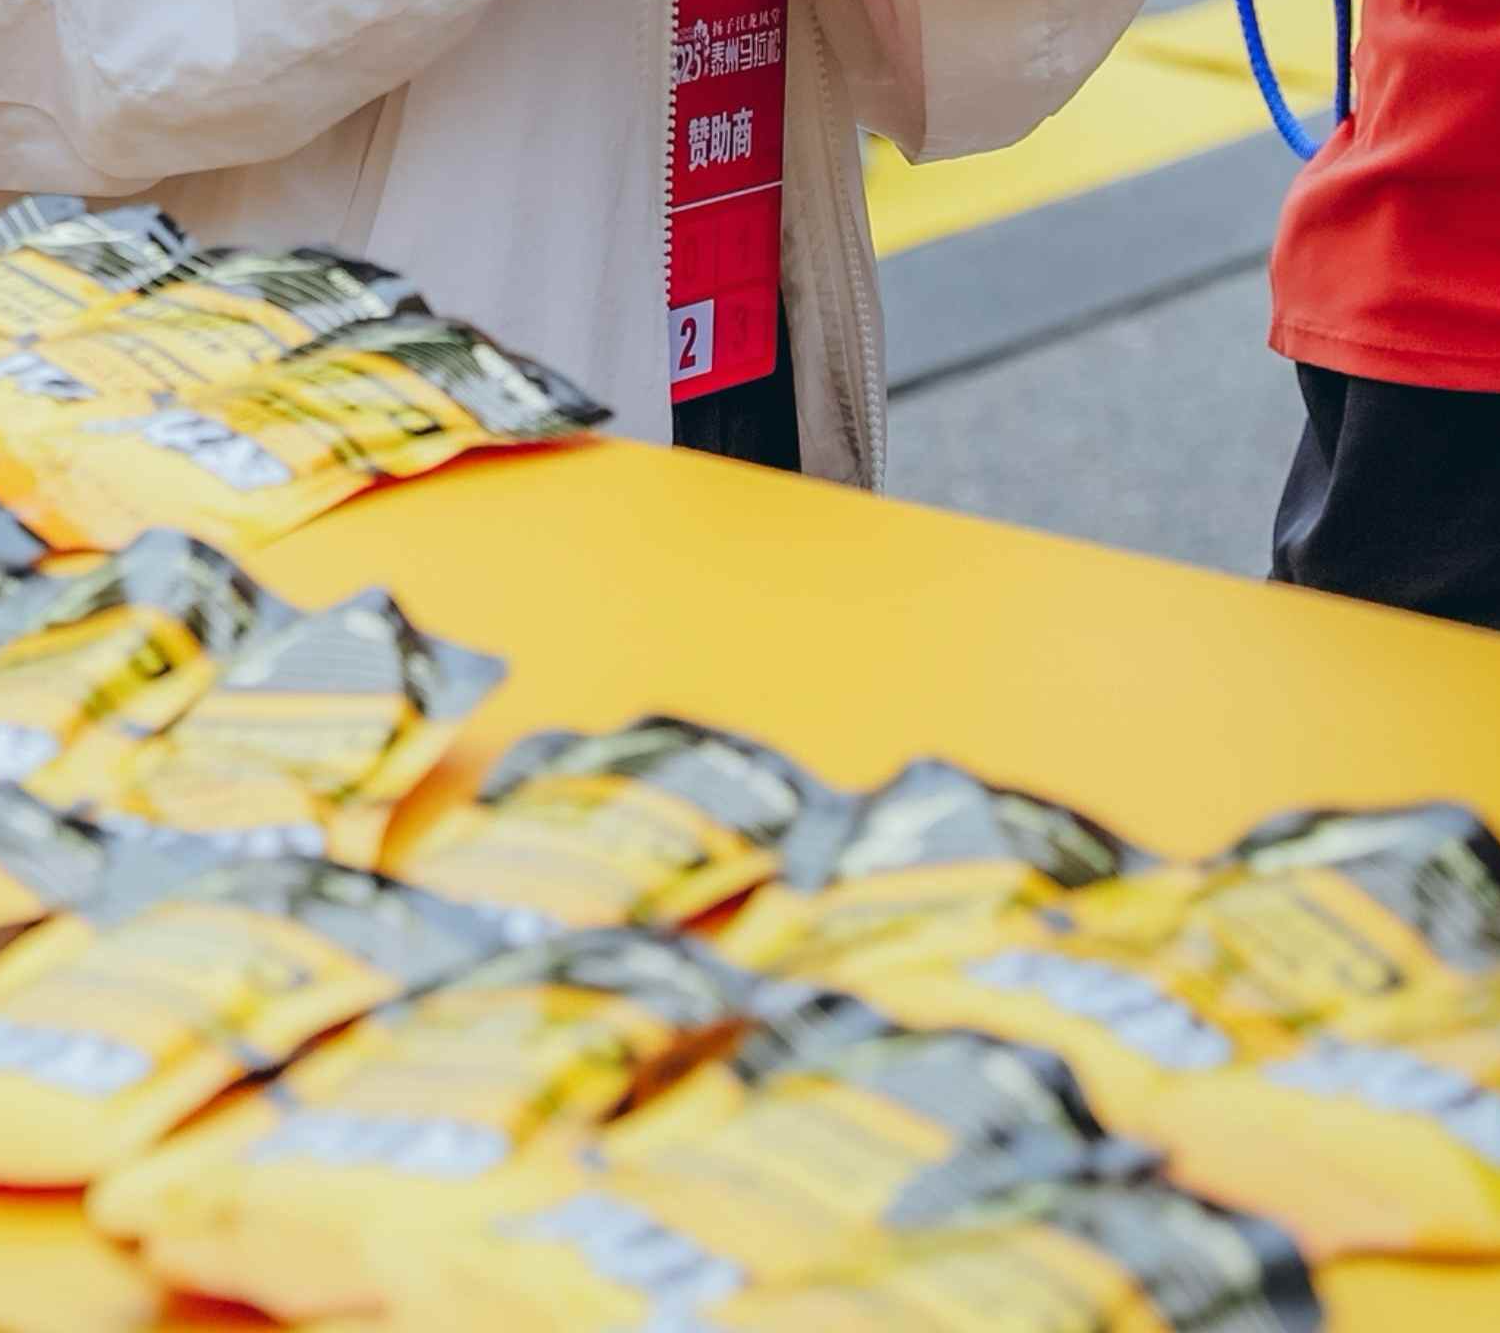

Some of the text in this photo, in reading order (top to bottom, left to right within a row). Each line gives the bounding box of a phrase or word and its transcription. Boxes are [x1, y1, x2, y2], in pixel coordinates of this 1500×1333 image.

[711, 28, 781, 77] 泰州马拉松
[687, 107, 754, 171] 赞助商
[679, 317, 697, 370] 2
